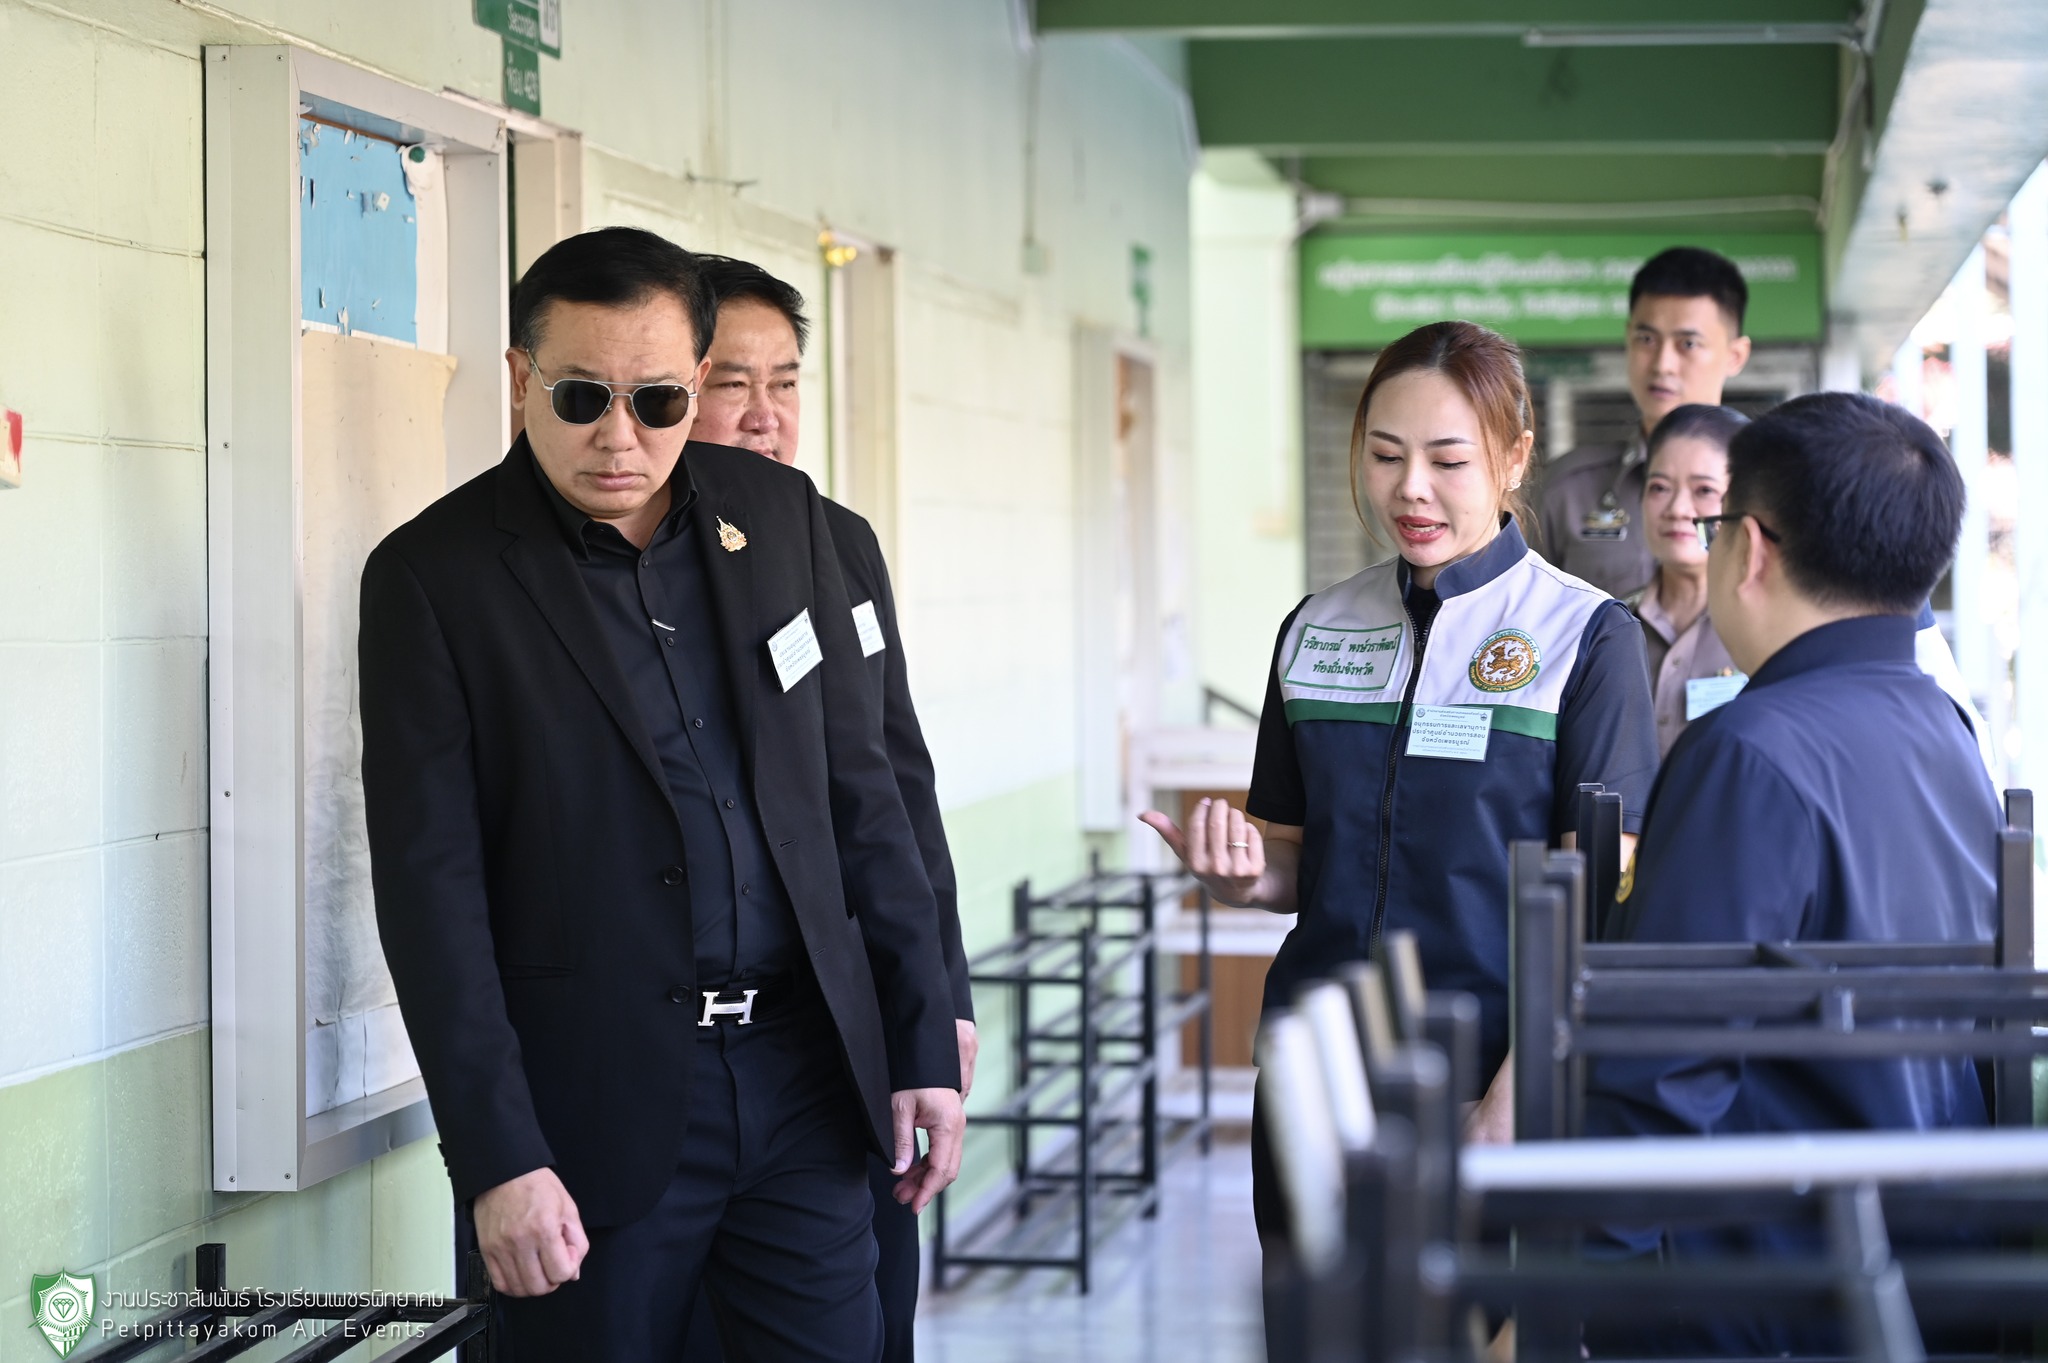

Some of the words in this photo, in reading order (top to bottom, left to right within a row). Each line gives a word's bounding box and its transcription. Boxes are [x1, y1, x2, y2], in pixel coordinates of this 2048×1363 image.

[1311, 658, 1374, 676] ท้องถิ่นจังหวัด
